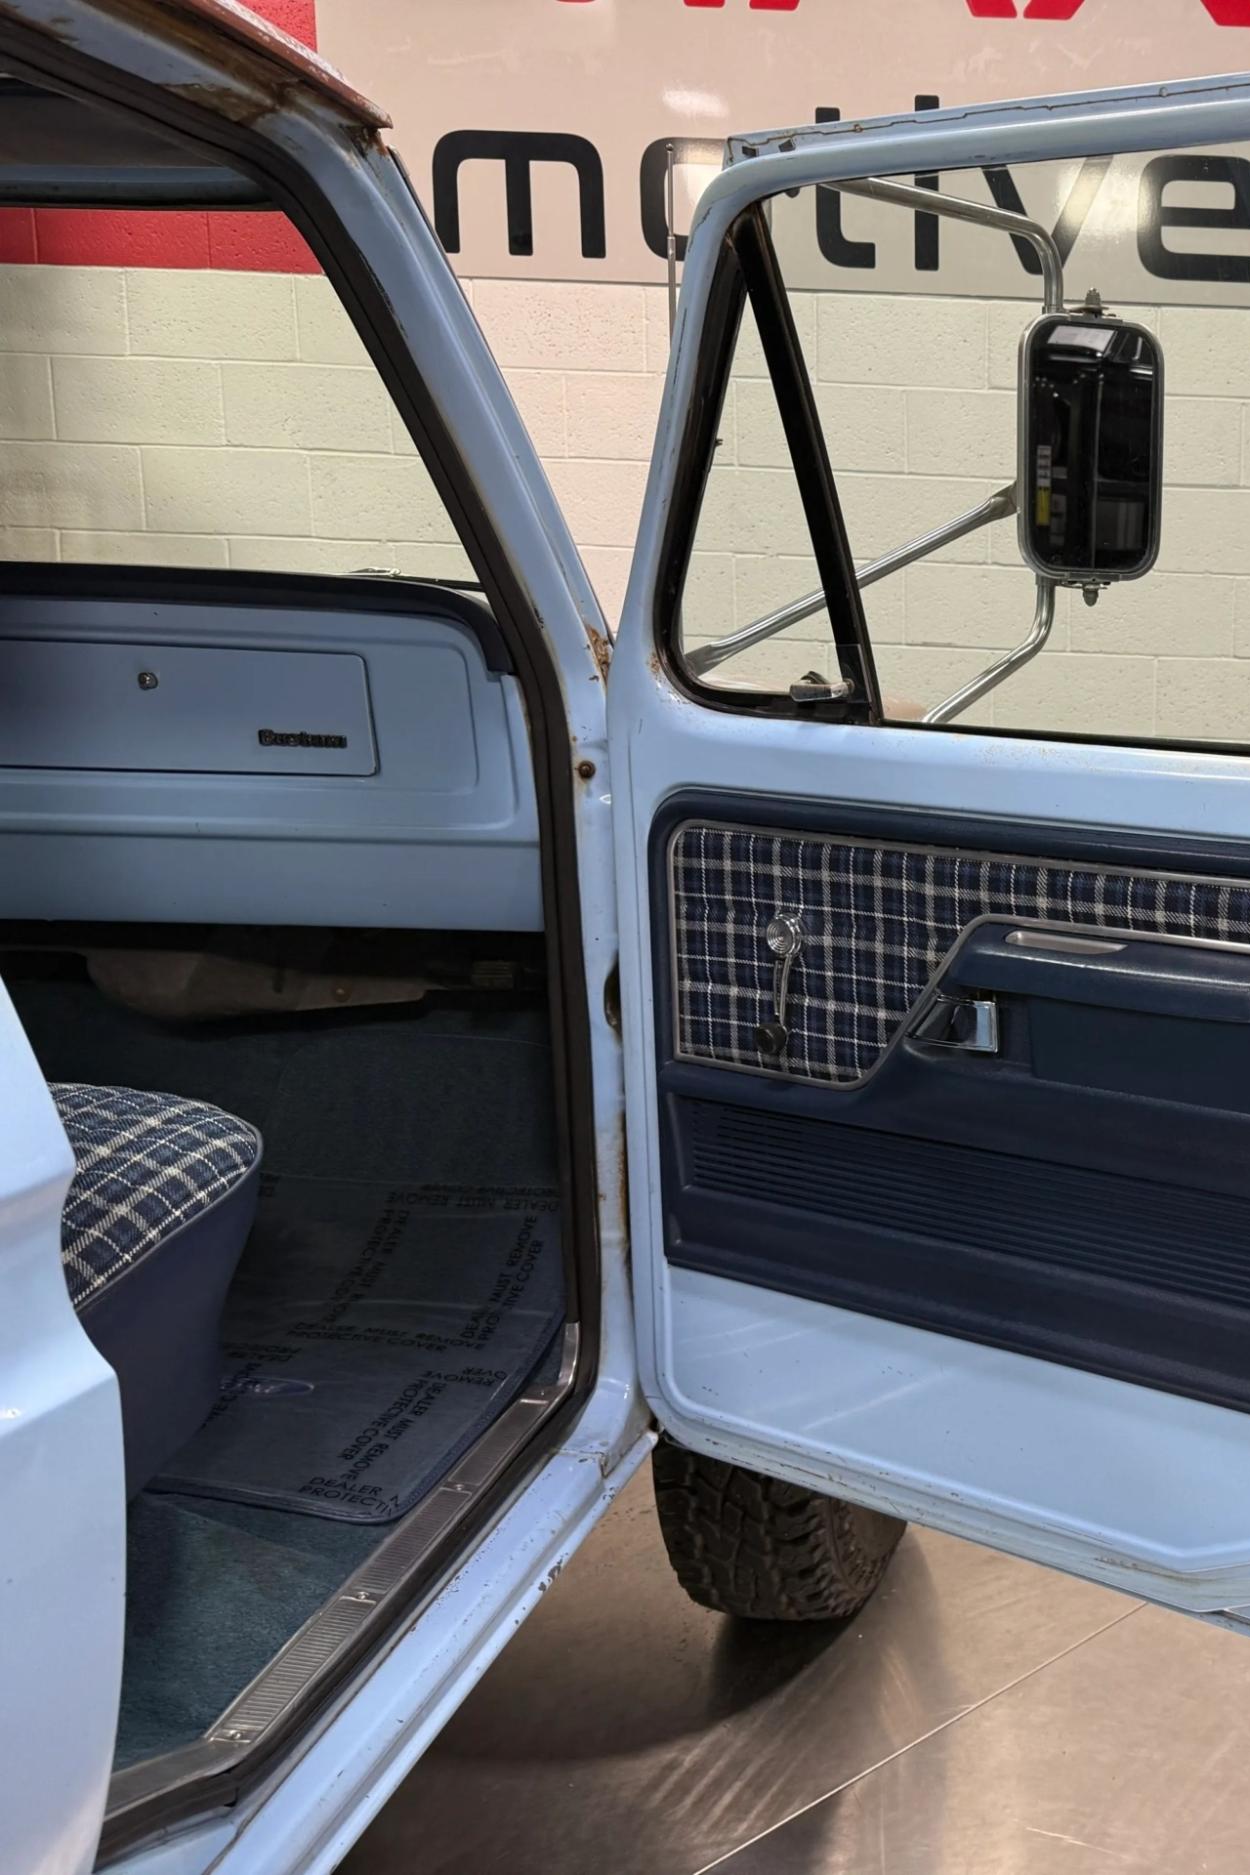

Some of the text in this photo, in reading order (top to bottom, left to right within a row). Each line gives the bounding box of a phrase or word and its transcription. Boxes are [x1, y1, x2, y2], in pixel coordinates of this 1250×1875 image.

[336, 1424, 381, 1462] COVER
[340, 1442, 391, 1482] REMOVE
[308, 1477, 383, 1496] DEALER
